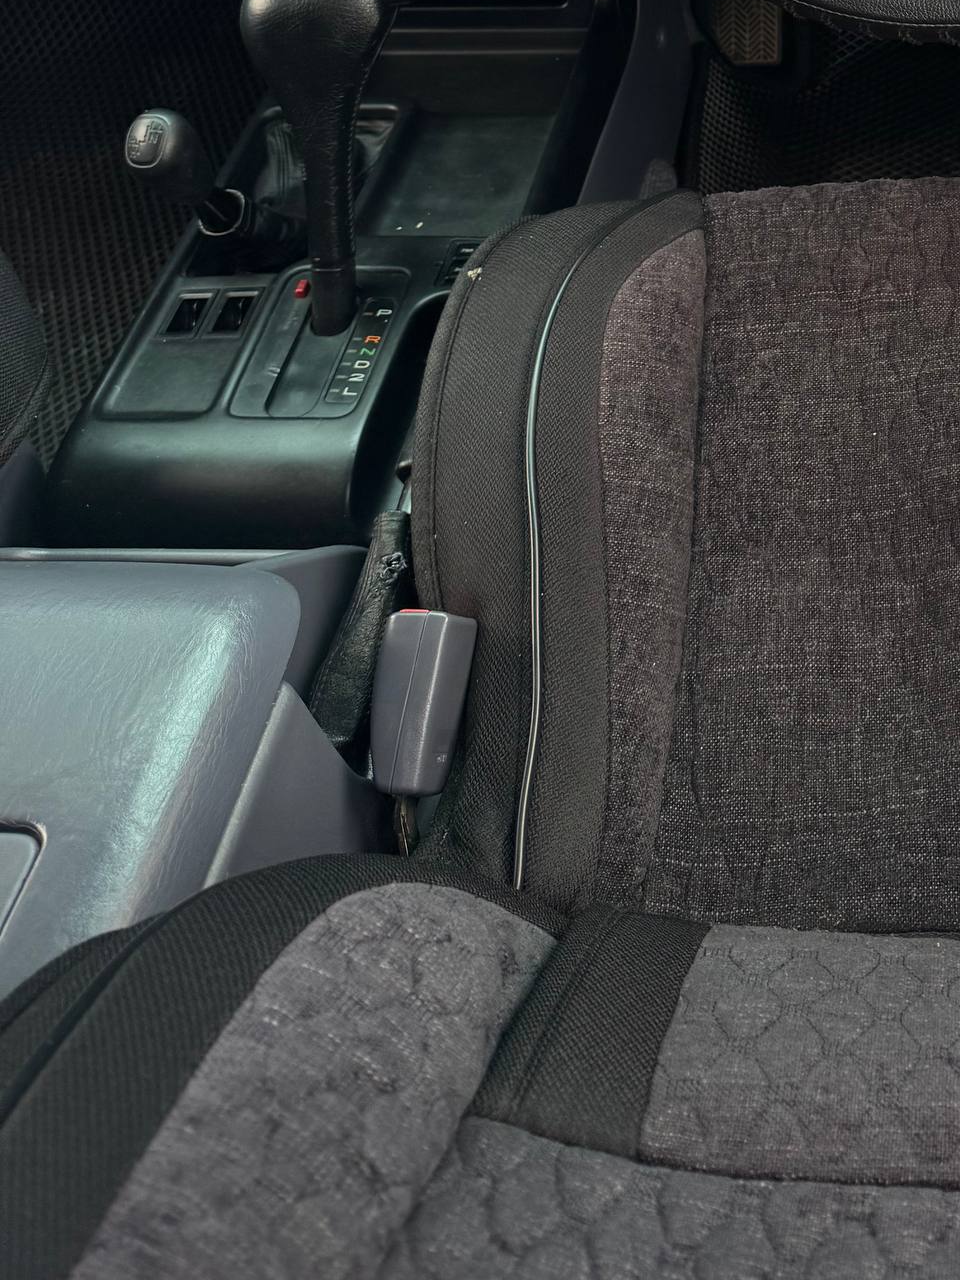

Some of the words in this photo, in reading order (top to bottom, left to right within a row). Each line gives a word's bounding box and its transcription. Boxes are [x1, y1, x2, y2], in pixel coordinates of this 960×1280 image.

[376, 309, 393, 317] P
[364, 335, 382, 343] R
[360, 348, 377, 356] N
[353, 360, 371, 369] D
[347, 373, 365, 382] 2
[342, 387, 358, 396] L
